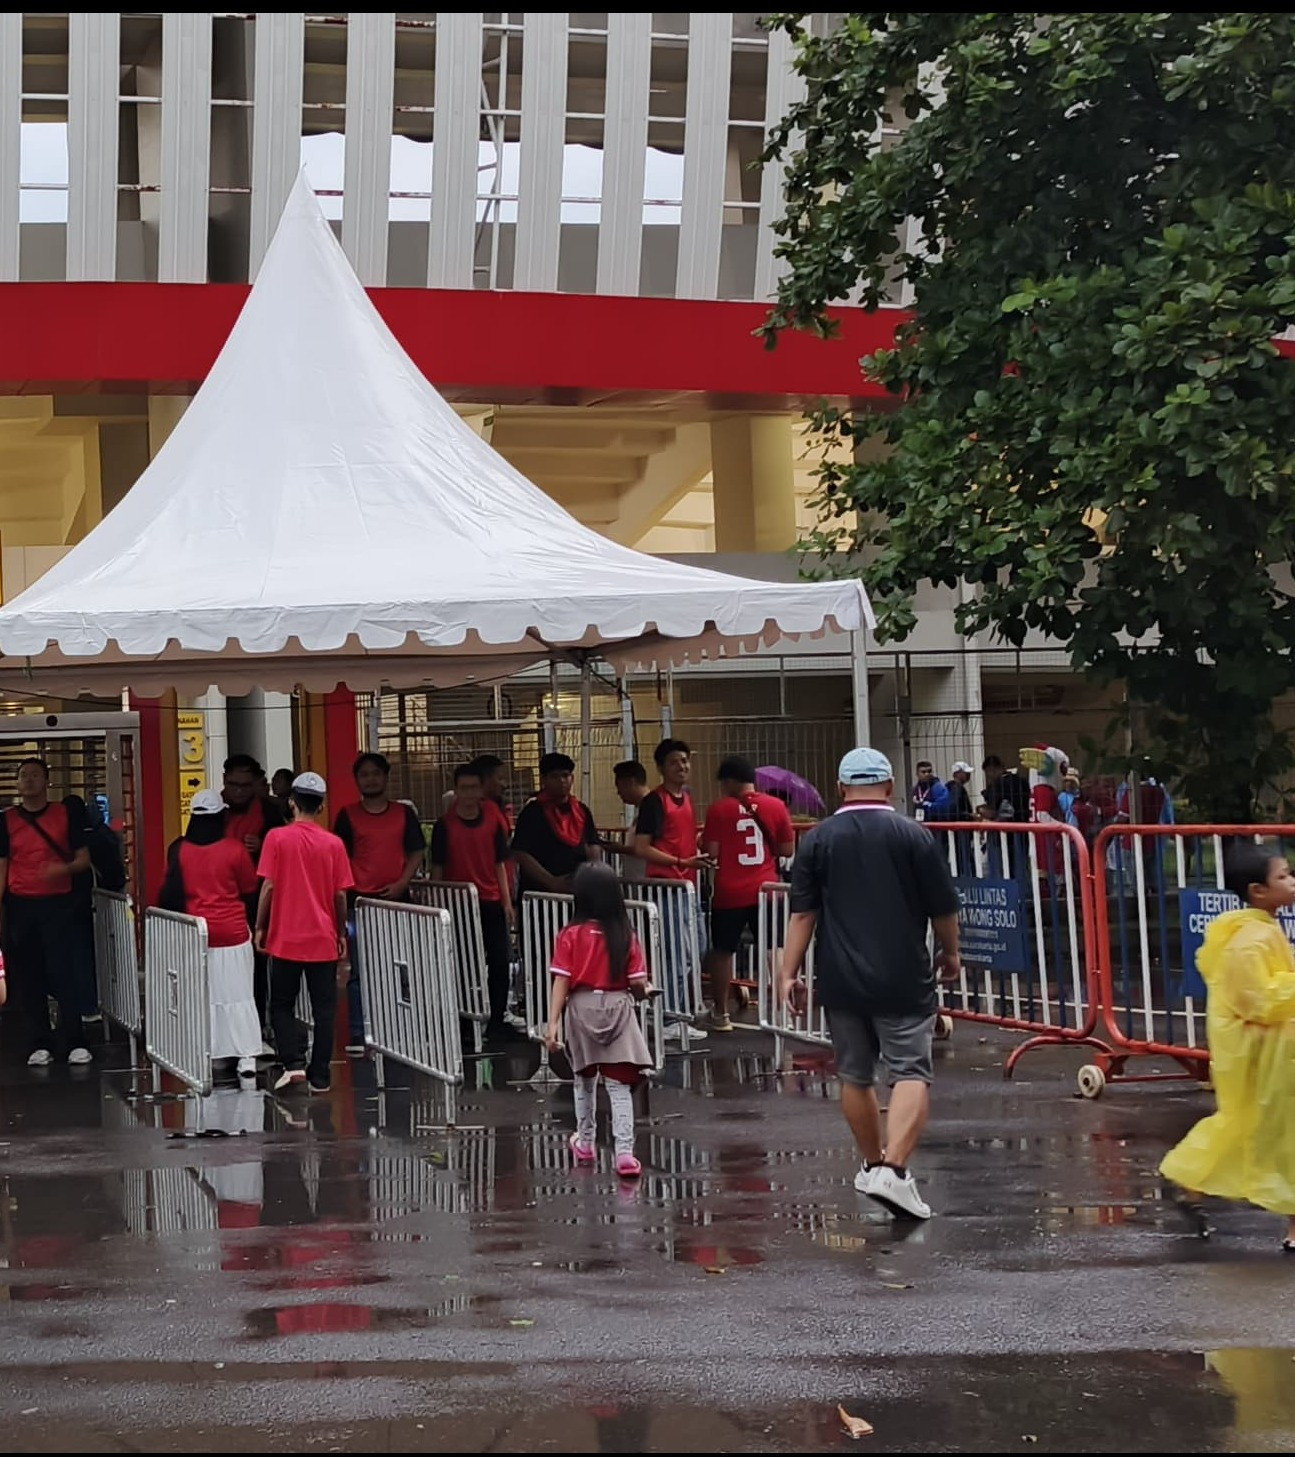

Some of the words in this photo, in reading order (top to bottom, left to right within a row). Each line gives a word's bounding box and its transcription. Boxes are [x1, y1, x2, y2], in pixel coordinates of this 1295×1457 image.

[184, 732, 204, 763] 3
[737, 818, 765, 866] 3
[980, 887, 1007, 906] LINTAS
[1198, 892, 1240, 913] TERTIB
[968, 908, 993, 928] WONG
[994, 909, 1017, 929] SOLO
